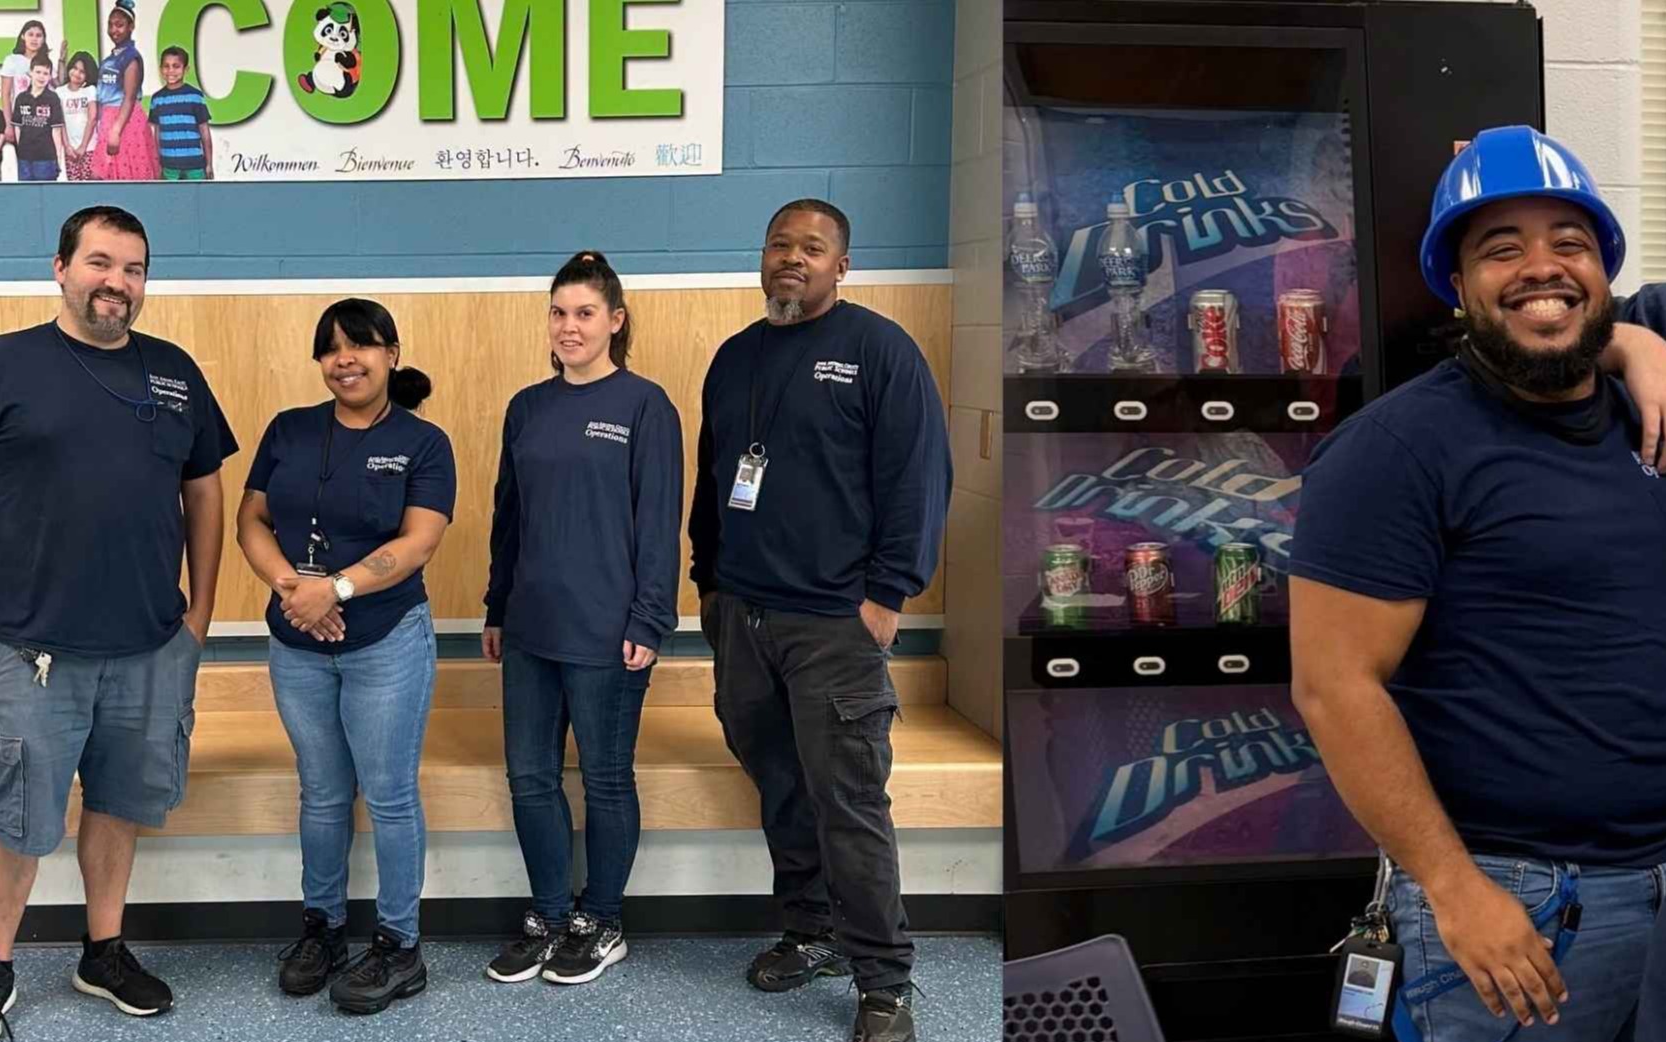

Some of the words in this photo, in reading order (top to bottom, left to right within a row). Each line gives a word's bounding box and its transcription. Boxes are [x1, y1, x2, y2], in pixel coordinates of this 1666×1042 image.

[335, 147, 415, 172] Bienvenue
[1123, 170, 1247, 217] Cold
[1050, 195, 1325, 311] Drinks
[1163, 708, 1282, 754] Cold
[1090, 731, 1319, 840] Drink
